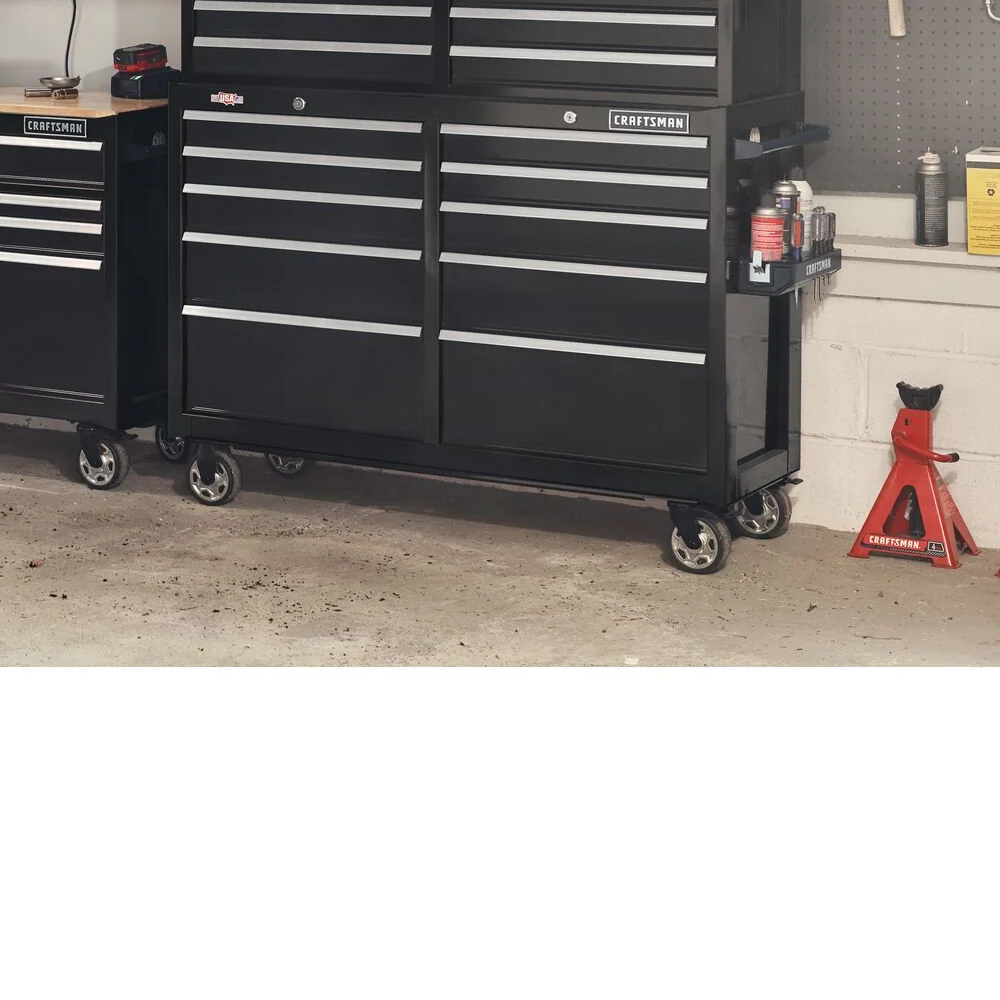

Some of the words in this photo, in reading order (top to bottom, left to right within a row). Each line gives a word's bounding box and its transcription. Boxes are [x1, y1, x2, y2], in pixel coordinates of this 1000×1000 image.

[220, 94, 235, 102] USA
[28, 120, 82, 133] CRAFTSMAN
[614, 115, 684, 129] CRAFTSMAN
[806, 258, 831, 276] CRAFTSMAN
[869, 535, 919, 549] CRAFTSMAN
